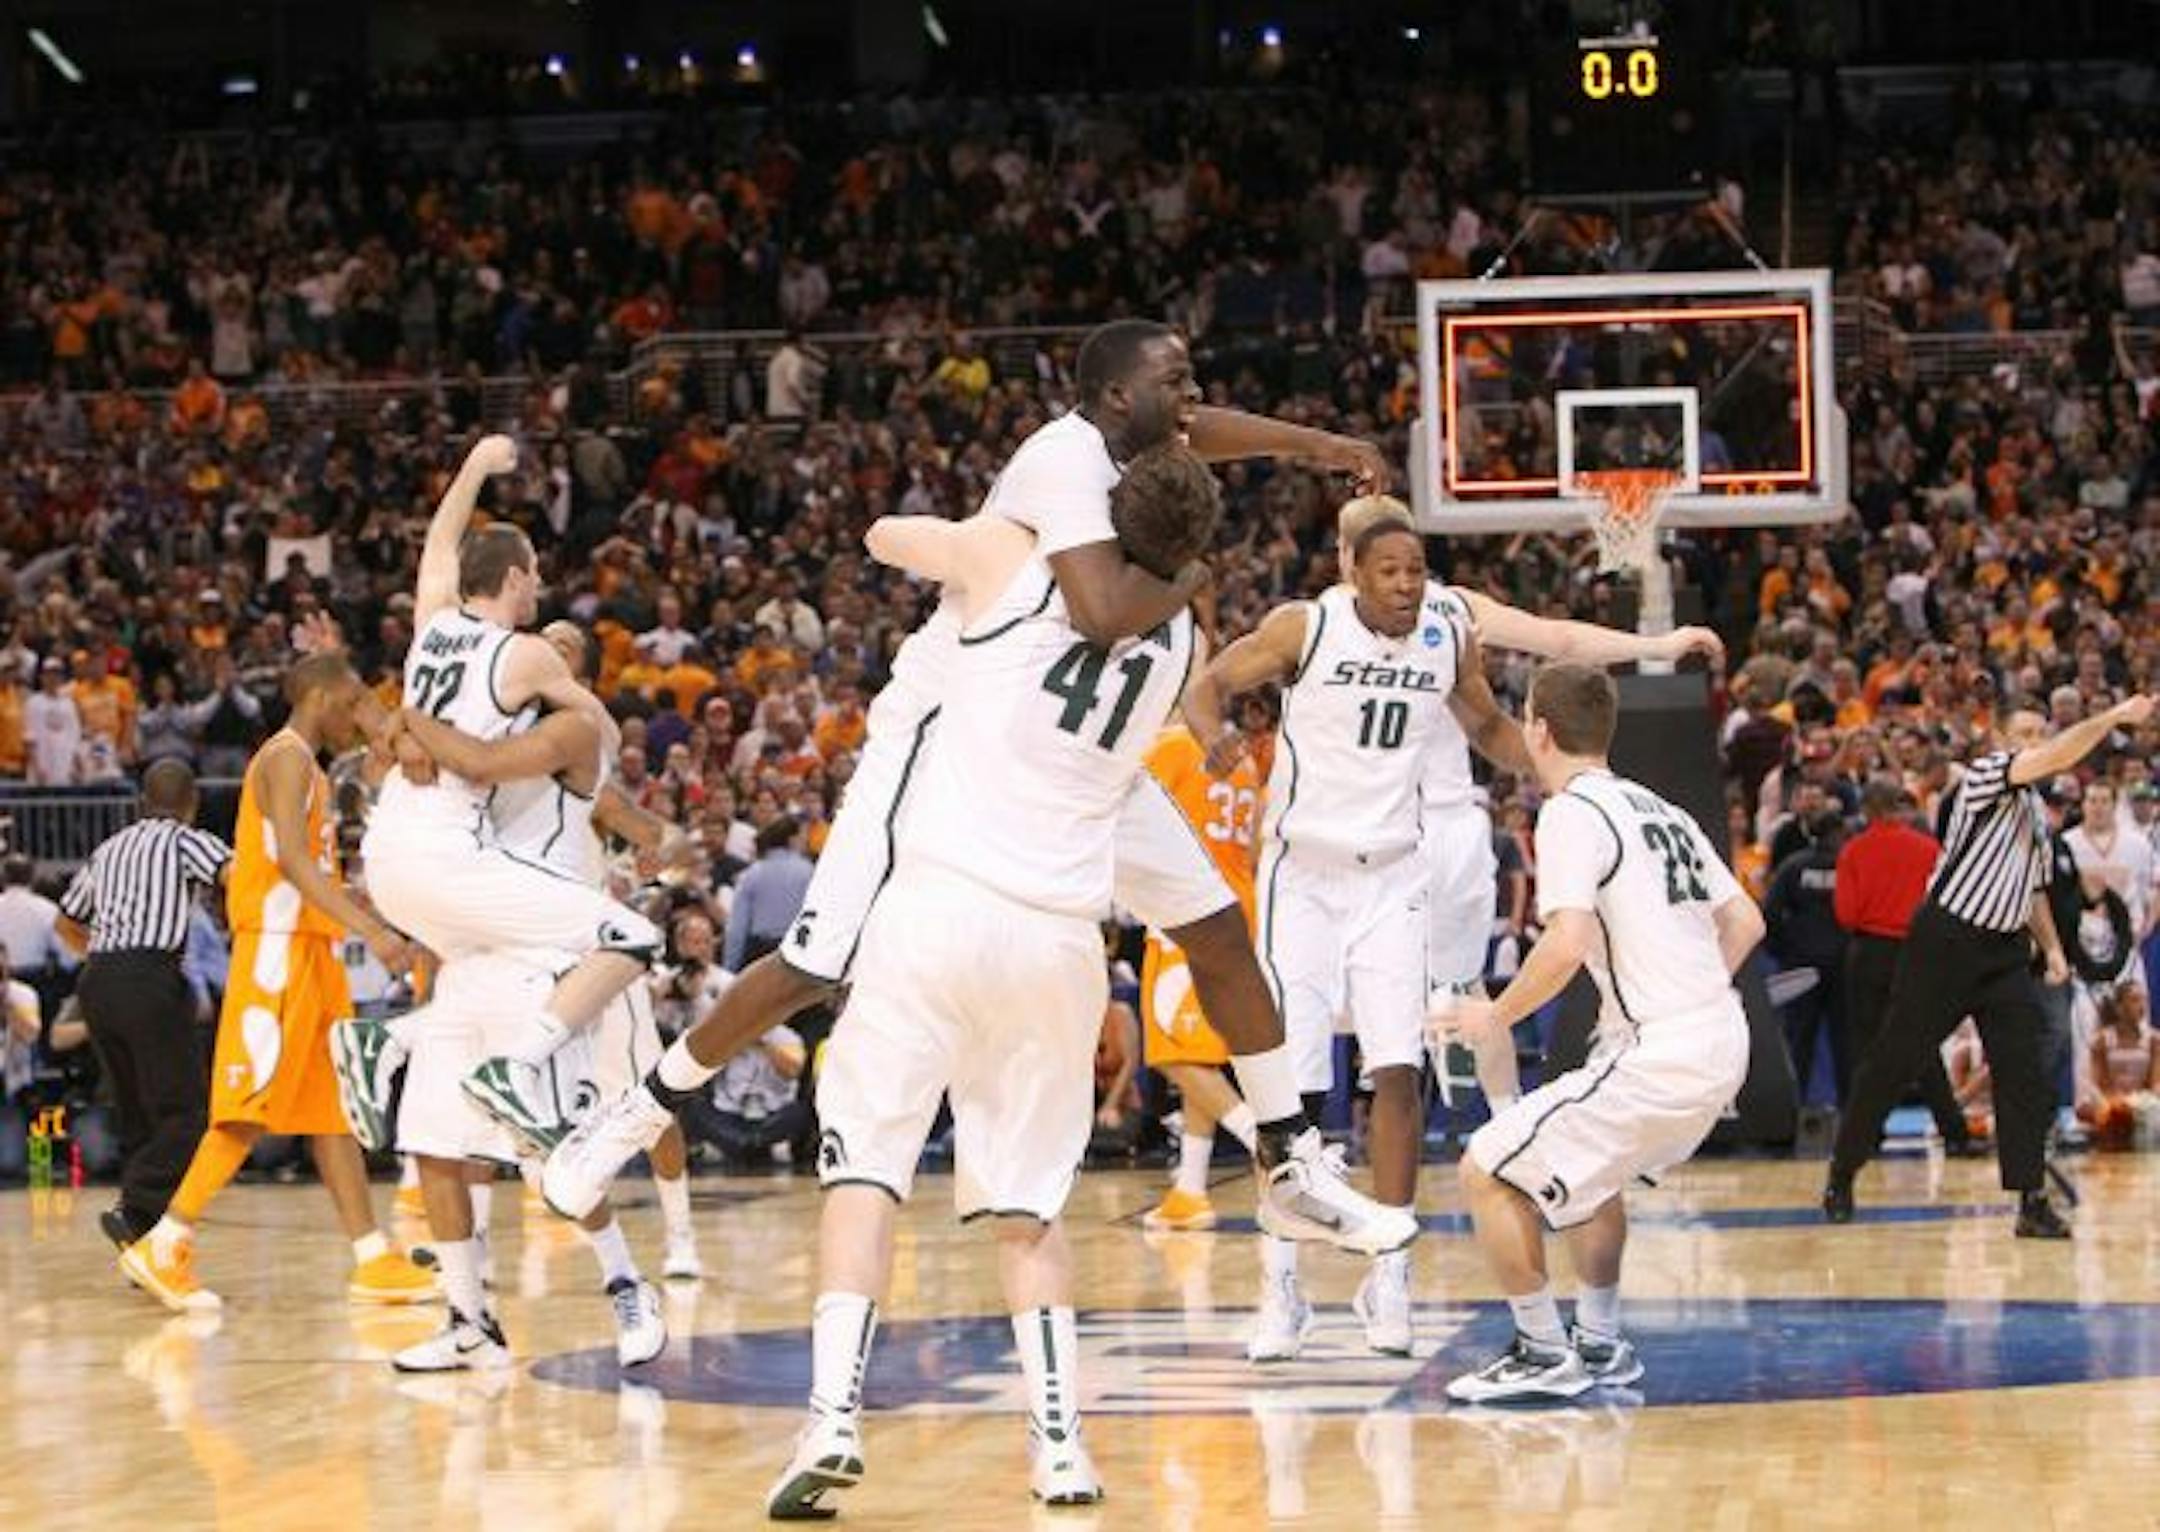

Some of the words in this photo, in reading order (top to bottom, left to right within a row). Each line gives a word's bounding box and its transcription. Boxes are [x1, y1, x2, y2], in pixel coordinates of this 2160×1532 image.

[1582, 51, 1657, 99] 0.0
[1042, 641, 1153, 752] 41
[1323, 660, 1441, 692] State
[1359, 698, 1409, 748] 10
[1205, 782, 1257, 845] 33
